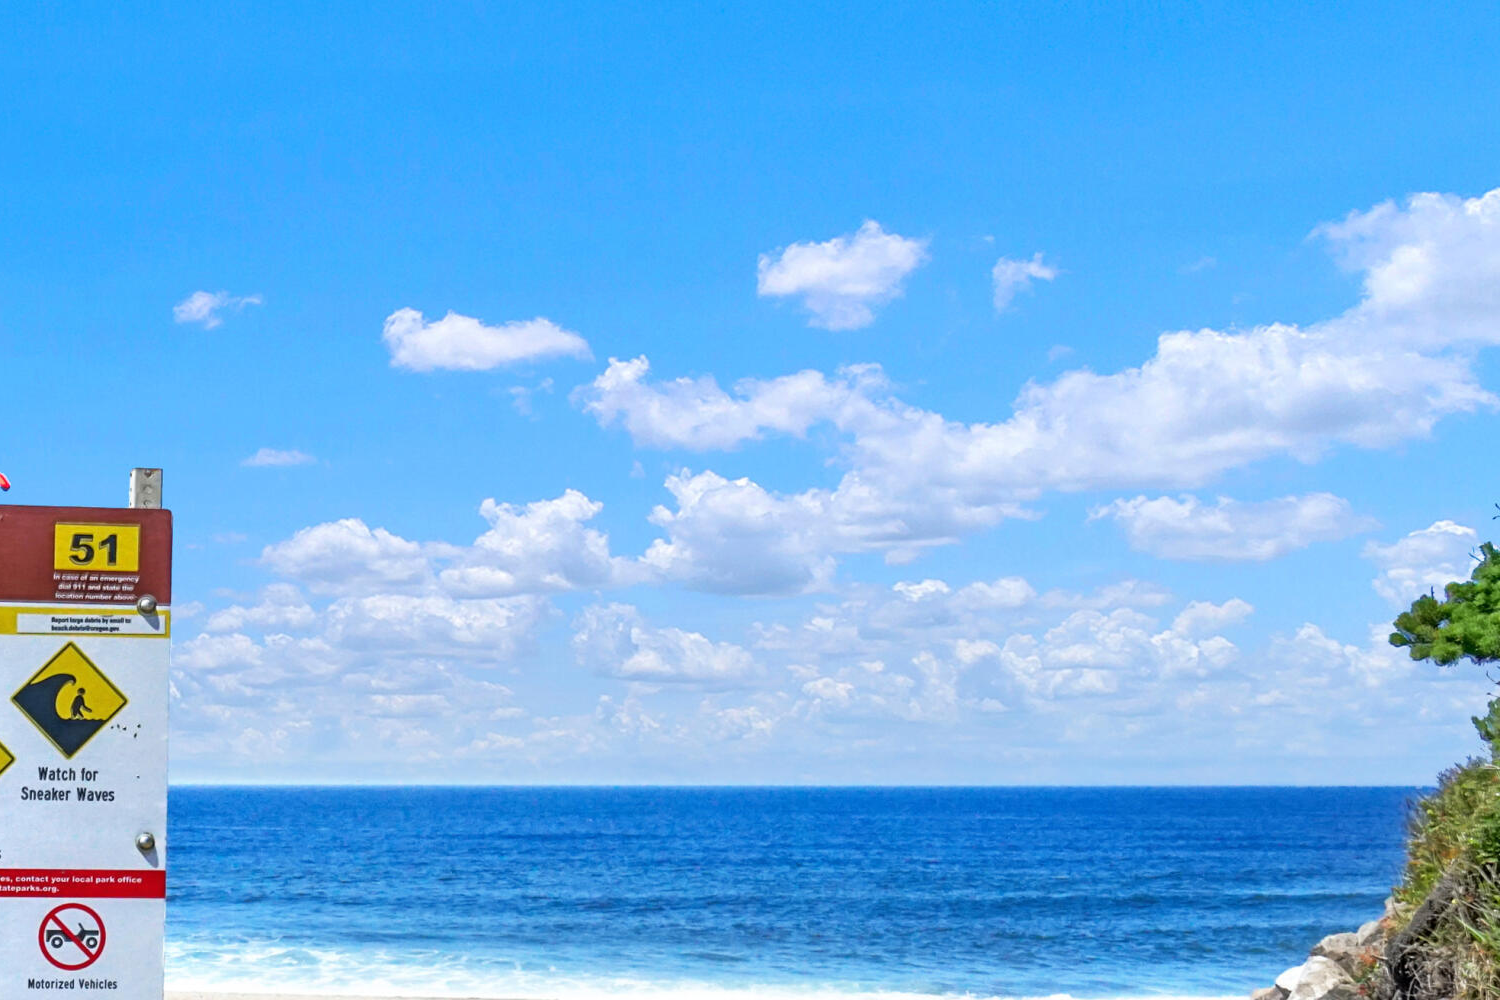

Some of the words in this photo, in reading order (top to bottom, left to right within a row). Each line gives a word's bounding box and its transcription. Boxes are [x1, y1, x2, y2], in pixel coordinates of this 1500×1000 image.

[68, 532, 120, 567] 51
[38, 766, 73, 782] Watch
[78, 766, 99, 782] for
[21, 786, 70, 801] Sneaker
[77, 787, 116, 802] Waves
[96, 876, 115, 884] park
[28, 979, 76, 991] Motorized
[80, 979, 118, 991] Vehicles
